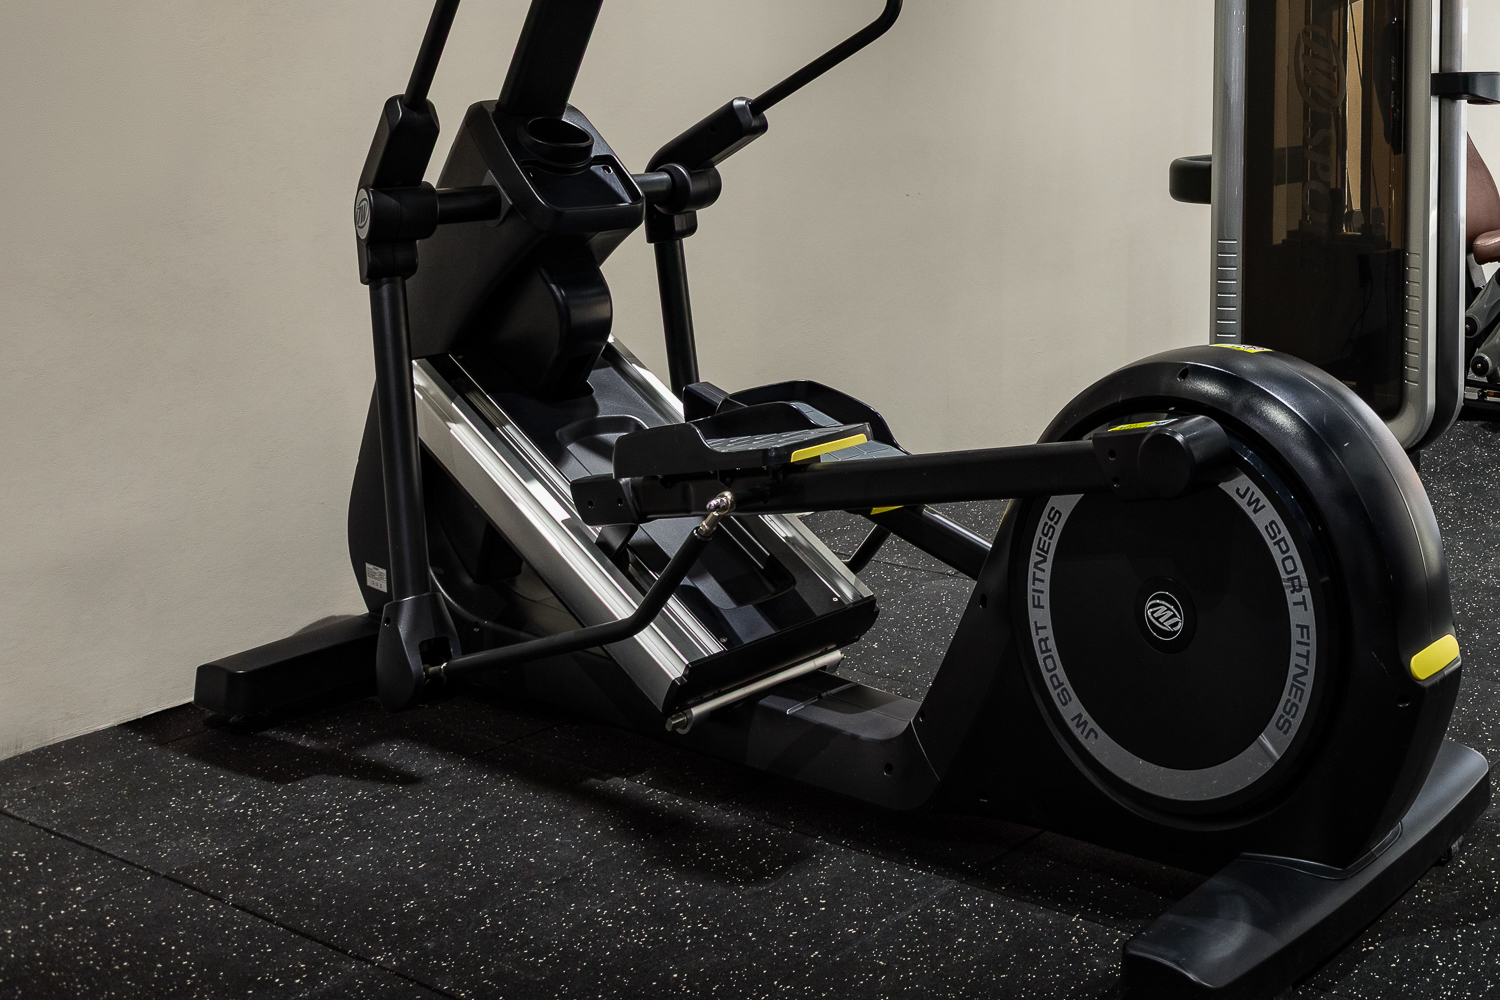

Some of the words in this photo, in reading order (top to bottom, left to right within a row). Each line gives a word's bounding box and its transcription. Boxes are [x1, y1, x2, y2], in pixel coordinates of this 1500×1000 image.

[1235, 485, 1266, 515] JW
[1031, 506, 1063, 610] FITNESS
[1264, 518, 1308, 612] SPORT
[1034, 620, 1073, 707] SPORT
[1275, 623, 1310, 735] FITNESS
[1070, 712, 1099, 742] JW
